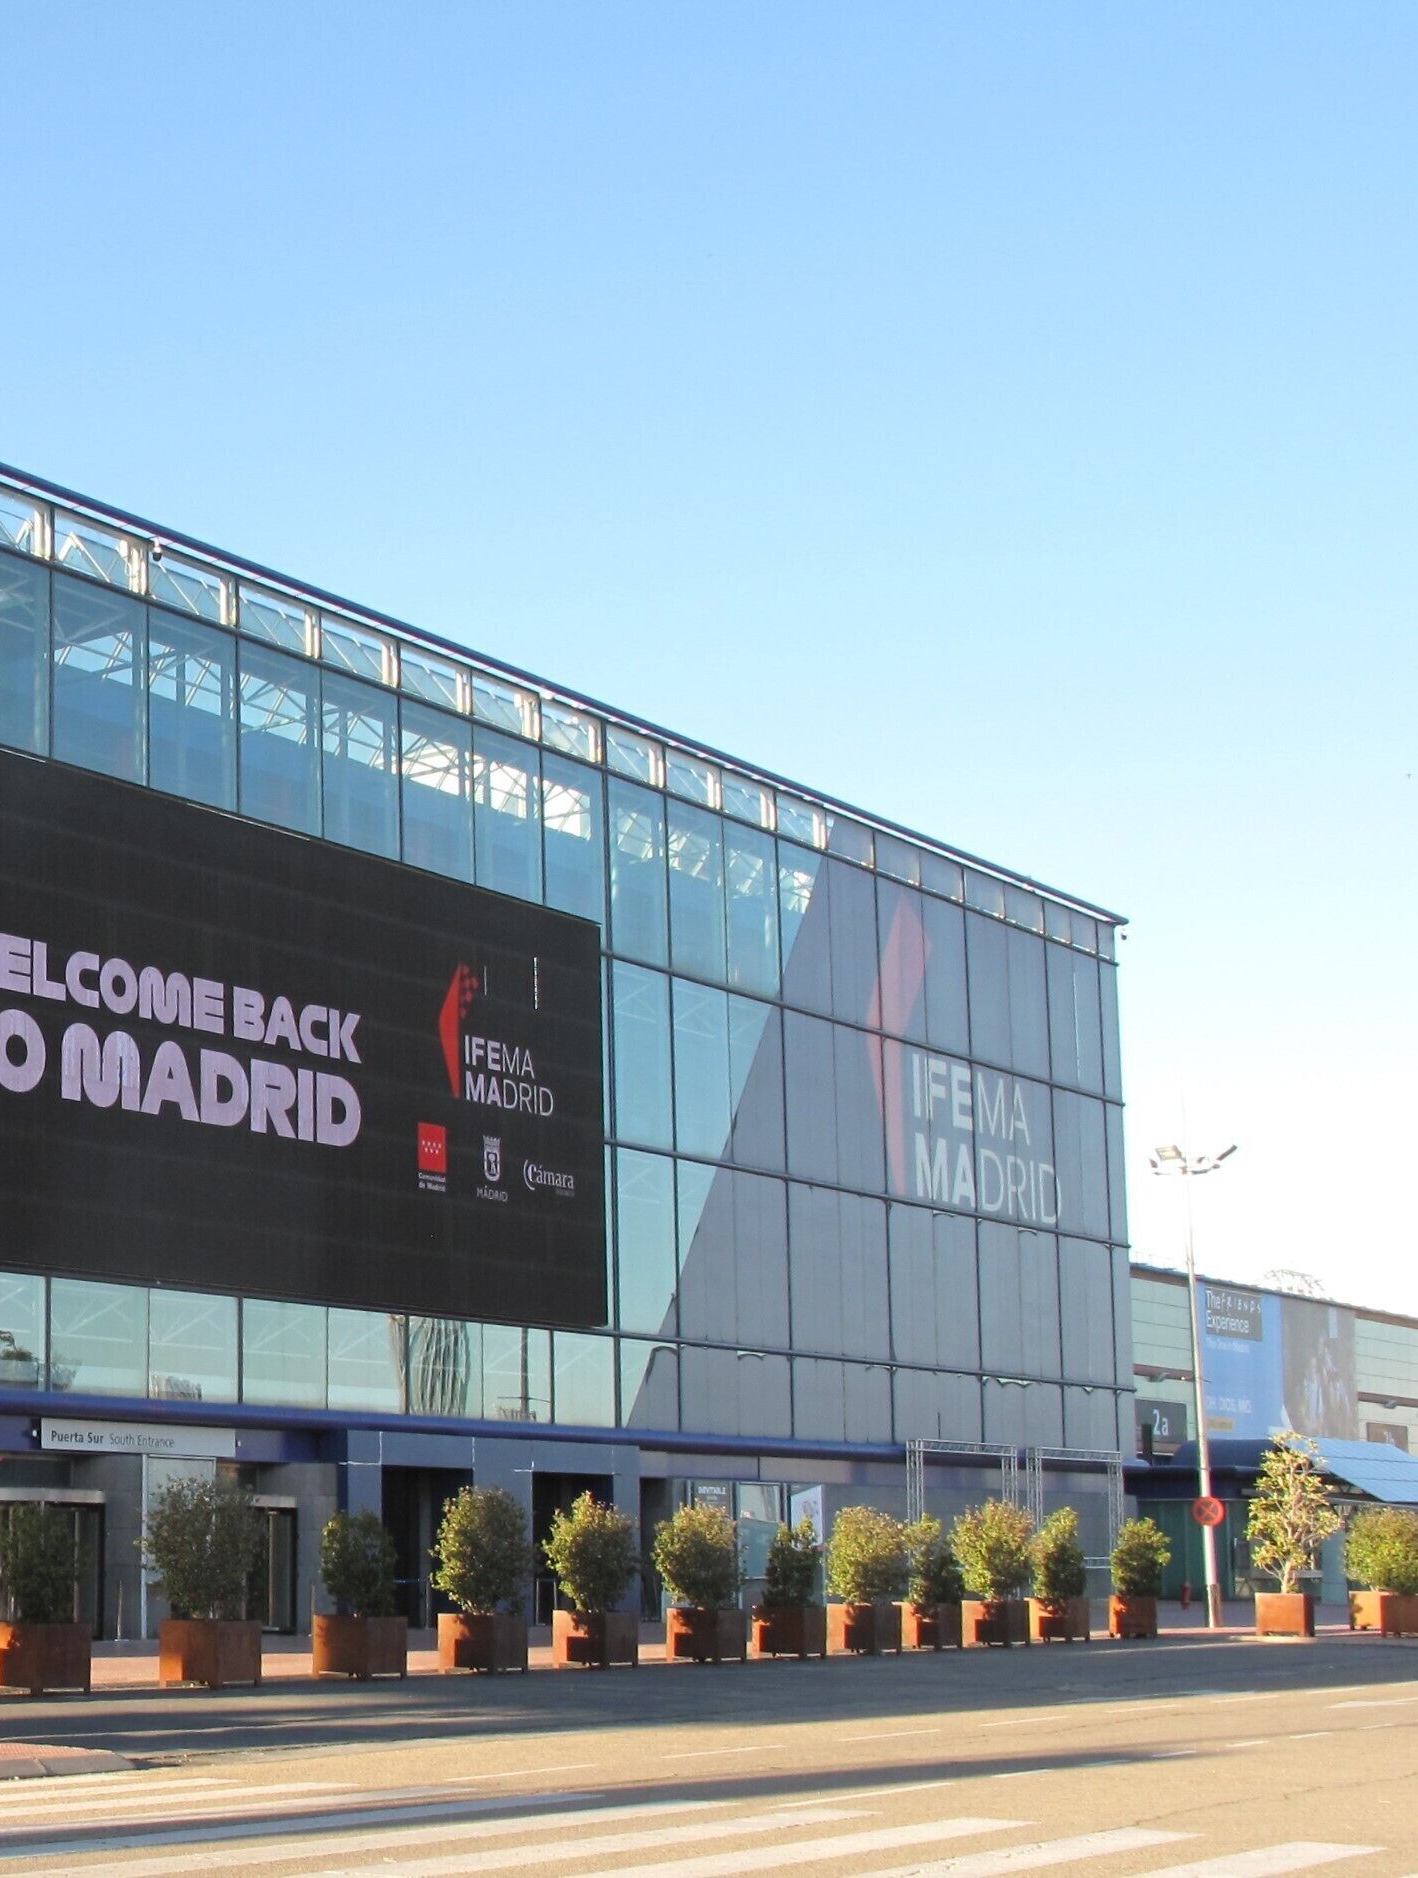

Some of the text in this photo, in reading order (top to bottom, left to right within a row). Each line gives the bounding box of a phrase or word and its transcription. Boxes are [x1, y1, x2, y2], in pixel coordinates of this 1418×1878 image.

[233, 986, 362, 1064] BACK
[465, 1035, 535, 1079] IFEMA
[61, 1022, 361, 1147] MADRID
[465, 1070, 554, 1116] MADRID
[912, 1054, 1030, 1145] IFEMA
[527, 1163, 574, 1189] Cámara
[915, 1132, 1061, 1224] MADRID
[51, 1430, 175, 1448] Puerta Sur South Entrance
[1153, 1409, 1169, 1436] 2a
